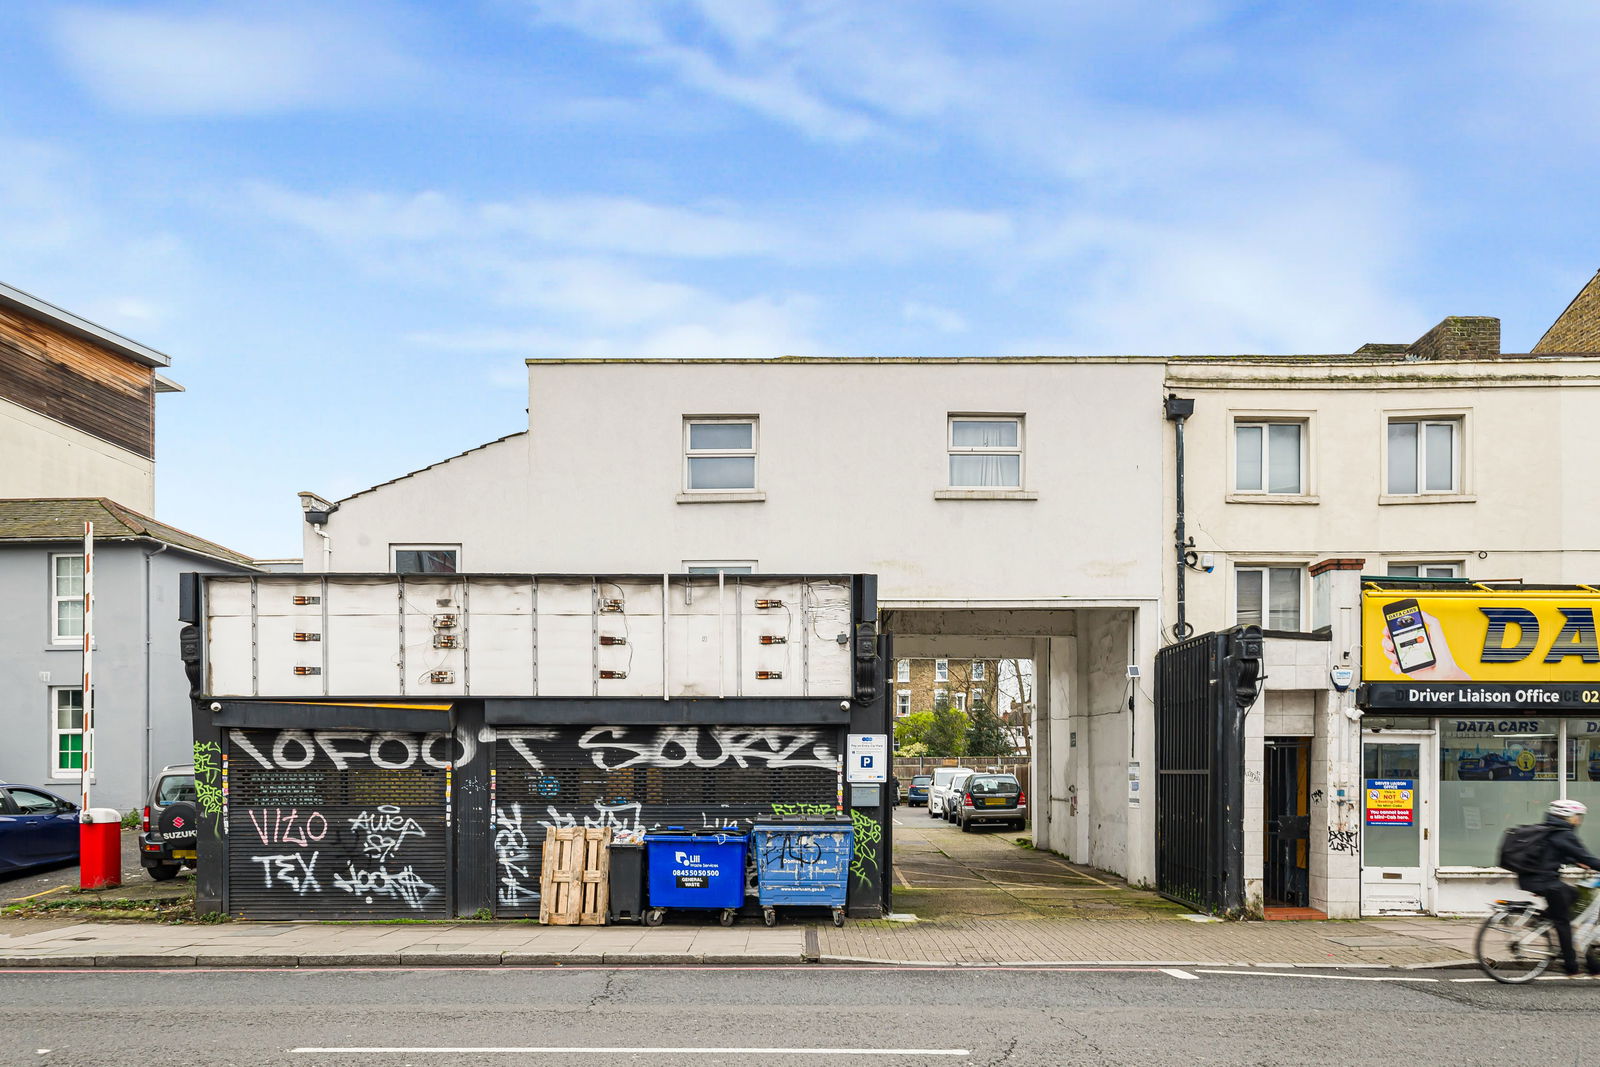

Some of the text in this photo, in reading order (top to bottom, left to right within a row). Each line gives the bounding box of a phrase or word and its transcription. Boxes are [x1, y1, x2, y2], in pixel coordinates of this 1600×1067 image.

[1388, 607, 1417, 619] DATA CARS
[1409, 689, 1455, 702] Driver
[1458, 689, 1511, 702] Liaison
[1515, 689, 1560, 702] Office
[1582, 690, 1600, 703] 02
[1456, 721, 1539, 732] DATA CARS
[864, 757, 870, 766] P
[163, 830, 197, 839] SUZUK
